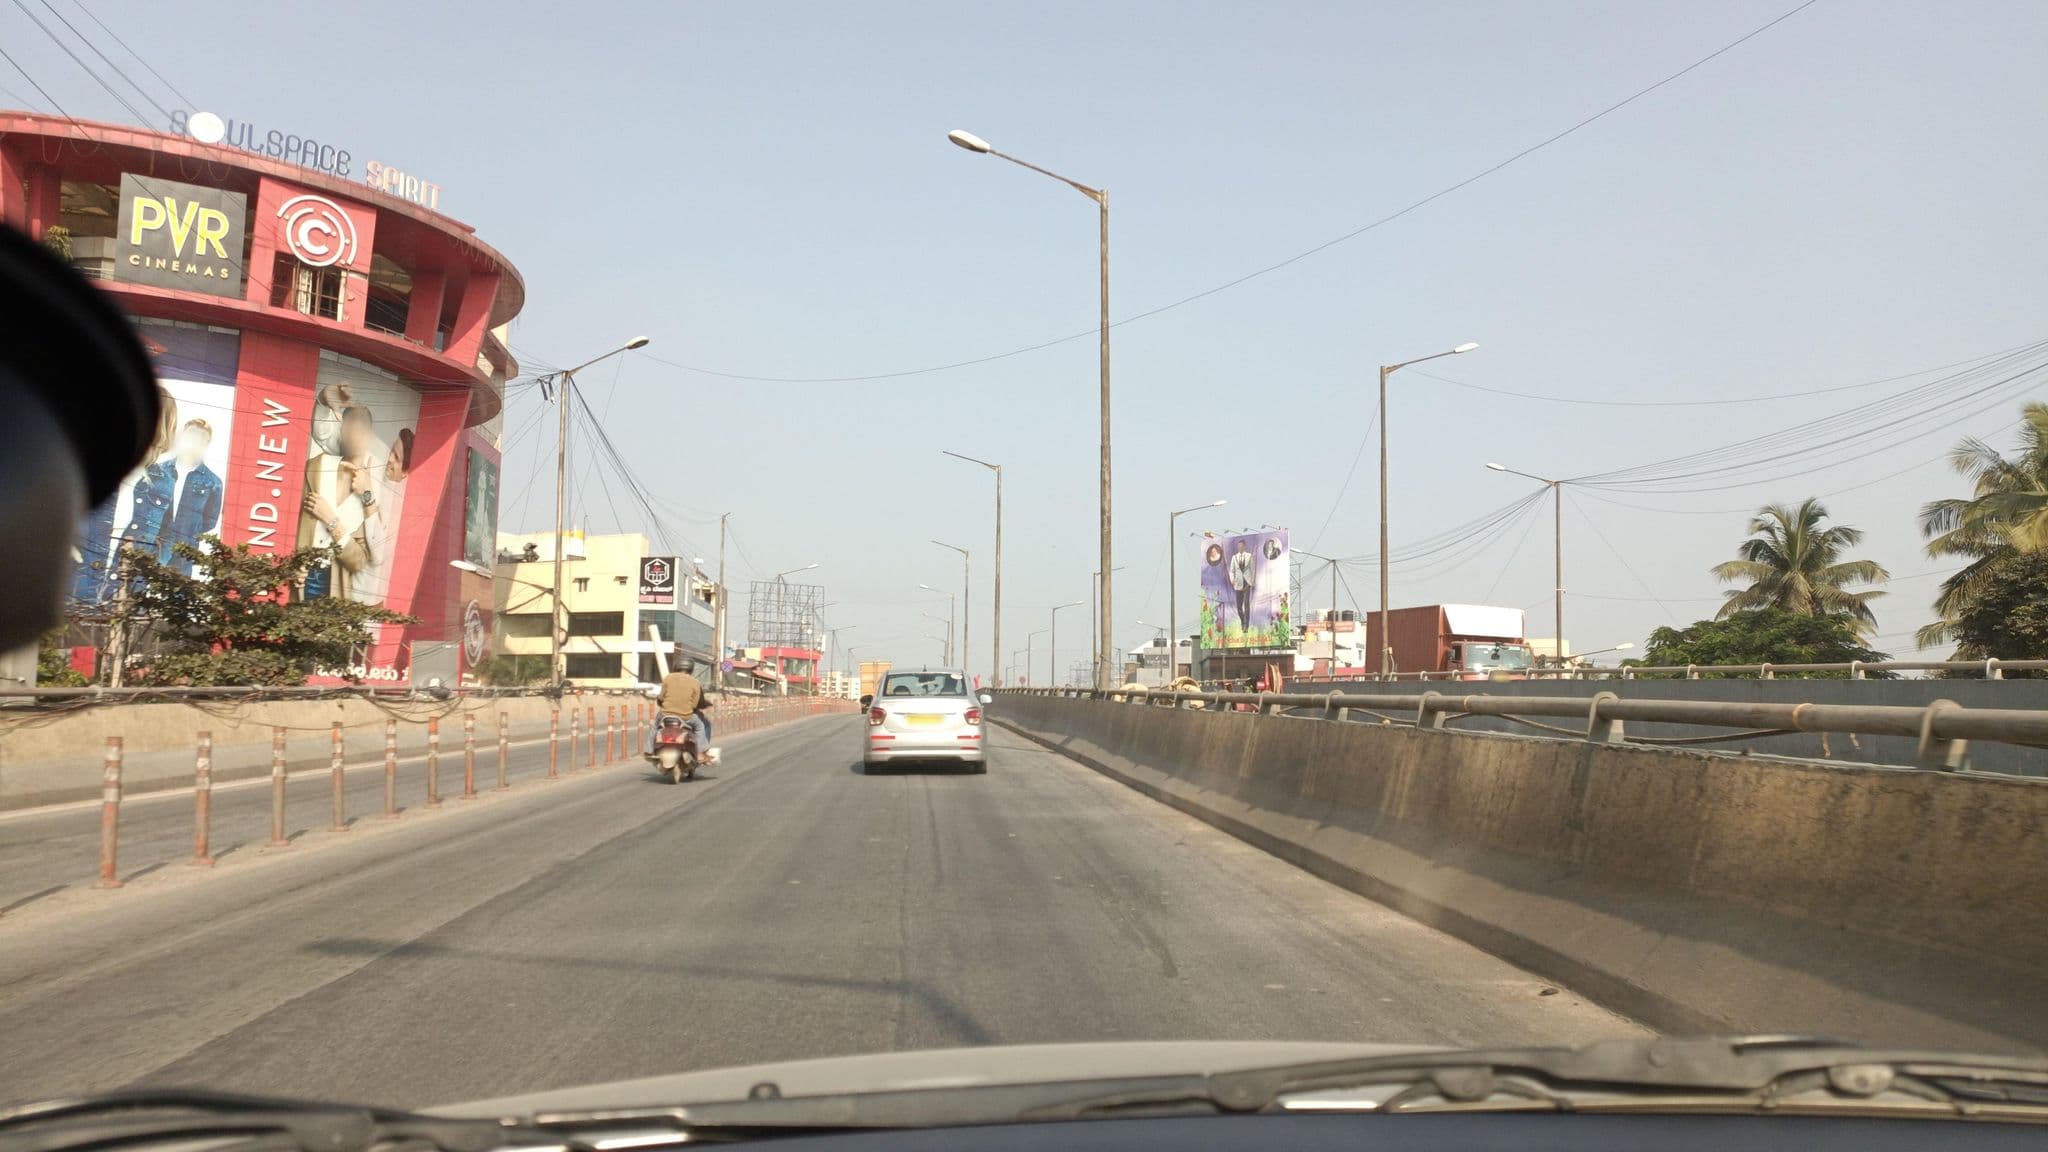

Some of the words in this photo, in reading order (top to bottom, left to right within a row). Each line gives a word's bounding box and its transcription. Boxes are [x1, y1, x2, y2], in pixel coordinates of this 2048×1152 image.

[366, 159, 444, 209] SPIRIT
[130, 196, 229, 259] PVR
[128, 254, 230, 280] CINEMAS
